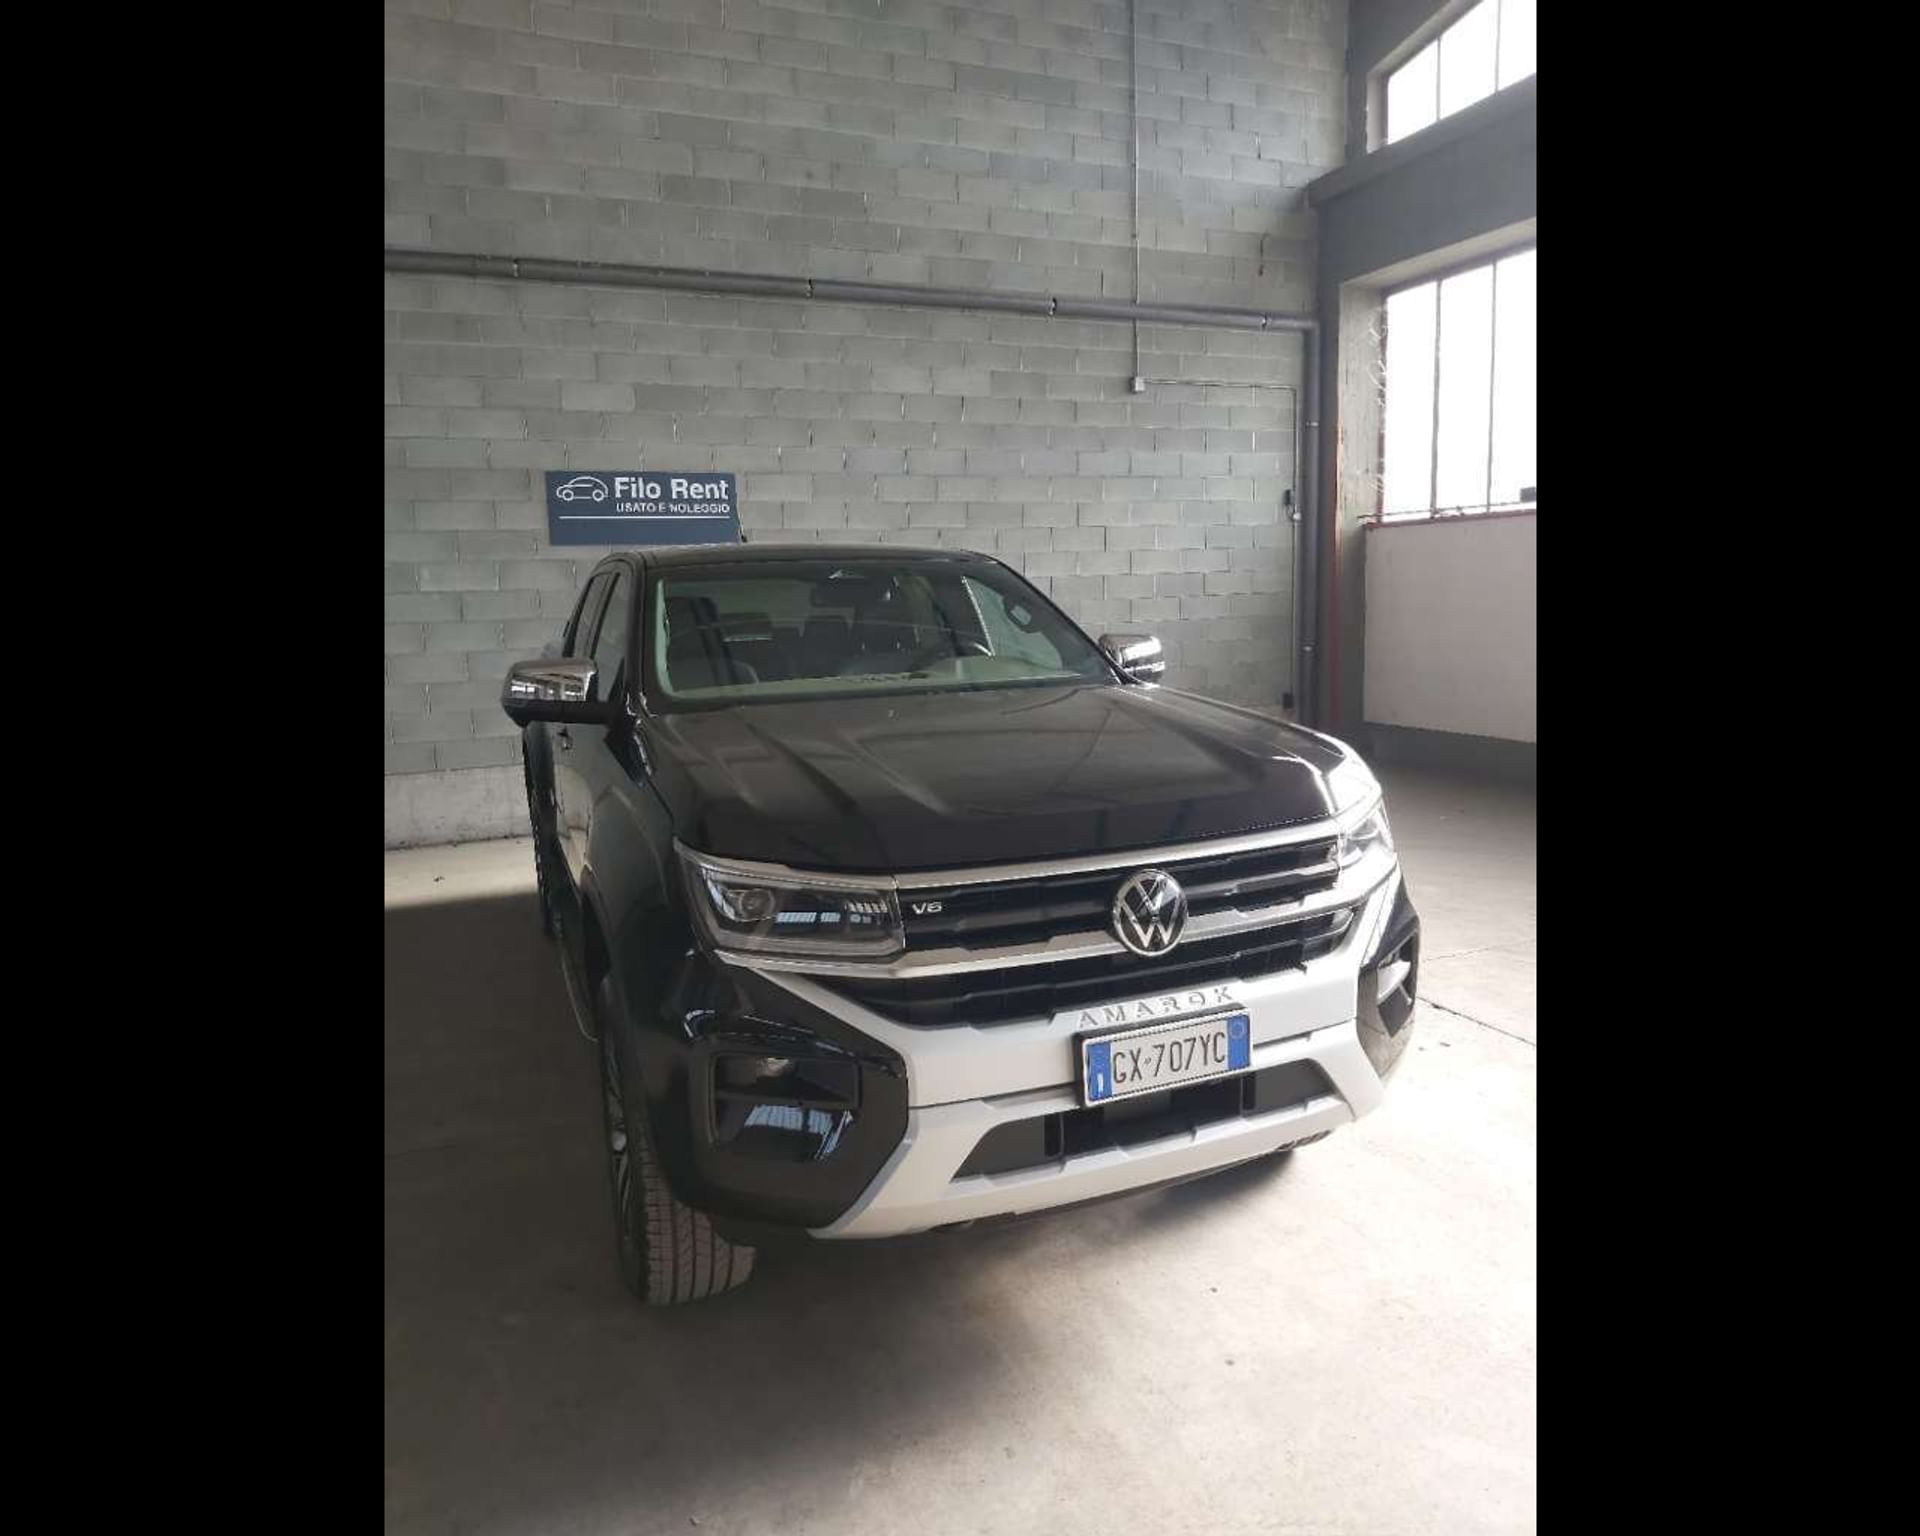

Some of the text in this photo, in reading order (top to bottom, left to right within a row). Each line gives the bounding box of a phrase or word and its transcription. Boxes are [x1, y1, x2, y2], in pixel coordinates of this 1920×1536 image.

[614, 477, 729, 500] Filo Rent
[616, 502, 730, 513] USATO E NOLEGGIO
[912, 901, 943, 914] V6
[1079, 986, 1233, 1028] AMAROK
